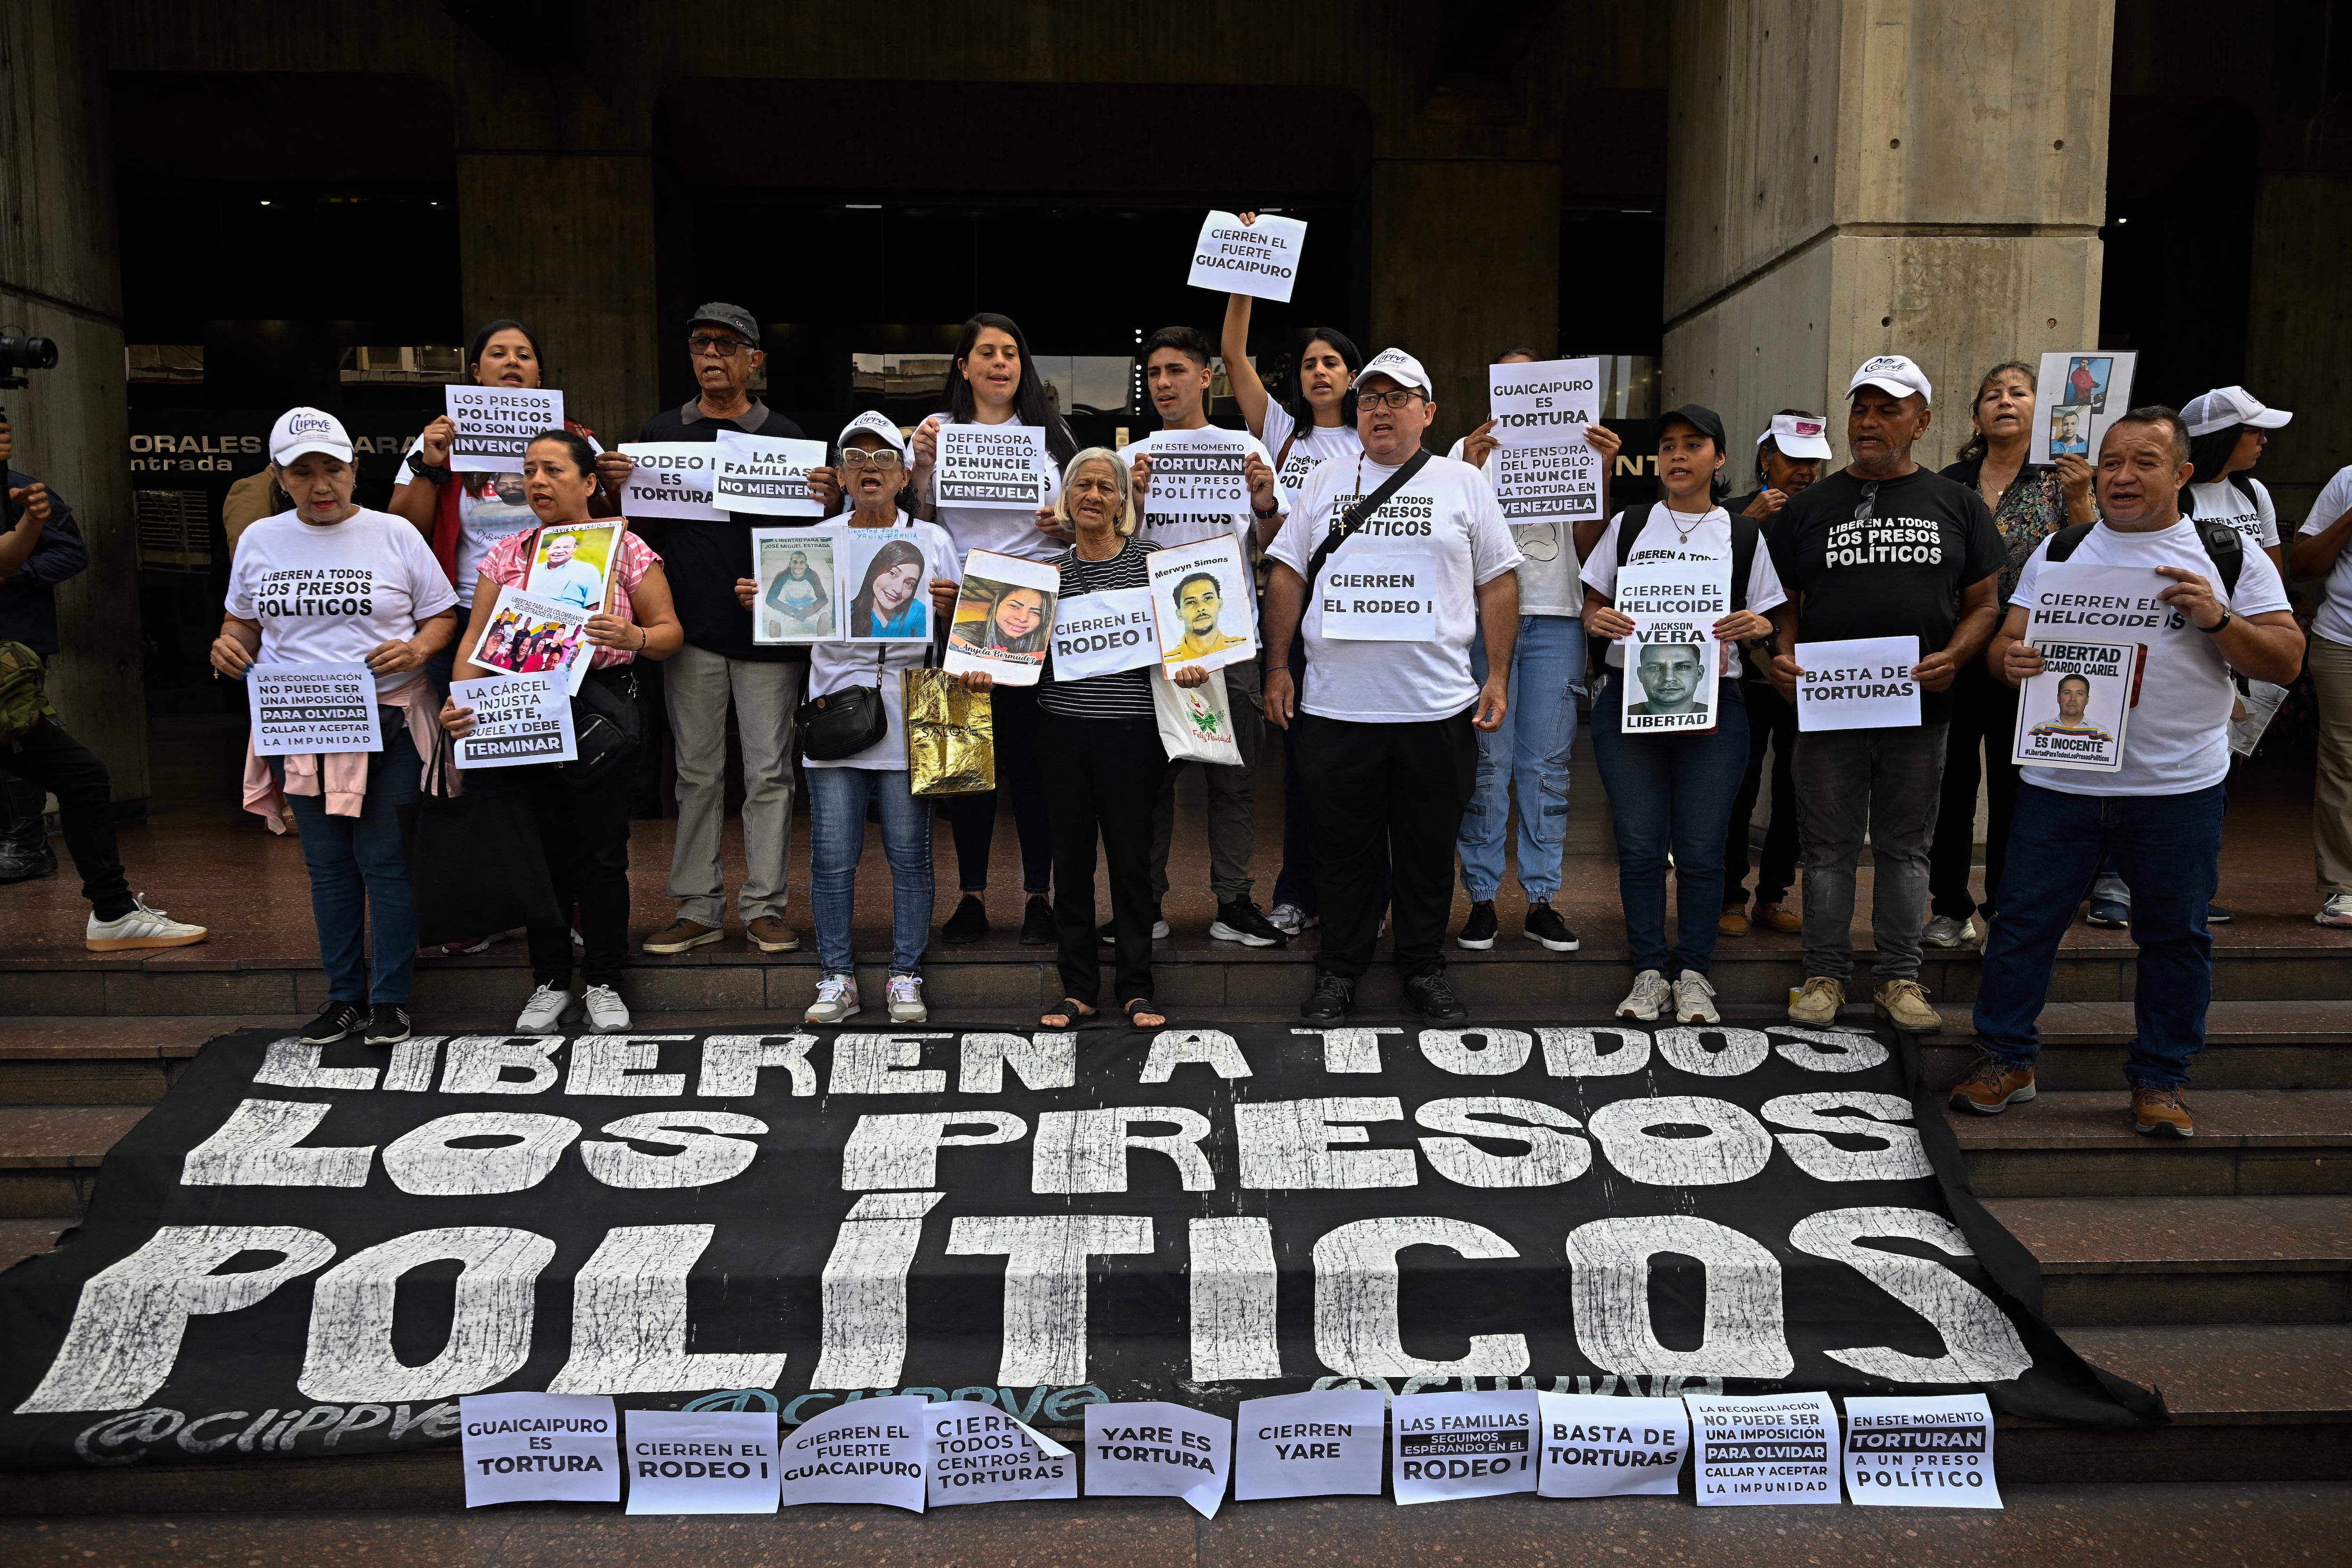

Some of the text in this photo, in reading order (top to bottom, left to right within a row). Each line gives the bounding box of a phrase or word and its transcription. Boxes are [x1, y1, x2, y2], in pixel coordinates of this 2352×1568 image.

[1211, 229, 1287, 249] CIERREN EL
[1221, 244, 1272, 260] FUERTE
[1196, 254, 1292, 278] GUACAIPURO
[1494, 380, 1593, 396] GUAICAIPURO
[454, 394, 550, 410] LOS PRESOS
[1536, 397, 1553, 408] ES
[457, 407, 552, 423] POLÍTICOS
[1500, 410, 1589, 428] TORTURA
[460, 422, 482, 433] NO
[485, 423, 515, 434] SON
[947, 433, 1032, 445] DEFENSORA
[753, 451, 787, 464] LAS
[946, 444, 1037, 457] DEL PUEBLO:
[725, 461, 813, 477] FAMILIAS
[946, 456, 1030, 470] DENUNCIE
[1152, 458, 1243, 471] TORTURAN
[660, 473, 682, 485] ES
[941, 469, 1038, 482] LA TORTURA EN
[1194, 476, 1240, 485] PRESO
[942, 484, 1037, 499] VENEZUELA
[1152, 485, 1241, 500] POLÍTICO
[1885, 518, 1895, 527] A
[1897, 517, 1939, 531] TODOS
[1828, 527, 1940, 549] LOS PRESOS
[1827, 546, 1941, 568] POLÍTICOS
[262, 569, 372, 582] LIBEREN A TODOS
[1154, 557, 1228, 579] Merwyn Simons
[259, 581, 371, 597] LOS PRESOS
[1330, 574, 1414, 588] CIERREN
[1622, 584, 1722, 596] CIERREN EL
[258, 595, 373, 618] POLÍTICOS
[511, 596, 532, 611] LIBERTAD
[532, 602, 544, 611] PARA
[552, 608, 585, 623] COLOMBIANOS
[1324, 599, 1432, 614] EL RODEO I
[1620, 600, 1723, 613] HELICOIDE
[2041, 593, 2161, 610] CIERREN EL
[514, 601, 547, 618] SECUESTRADOS
[553, 612, 578, 626] VENEZUELA
[2034, 610, 2160, 627] HELICOIDE
[1055, 611, 1151, 635] CIERREN EL
[1055, 627, 1152, 657] RODEO I
[1636, 630, 1706, 643] VERA
[960, 643, 1036, 665] Anyela Bermúdez
[2041, 644, 2122, 663] LIBERTAD
[1805, 665, 1908, 683] BASTA DE
[259, 684, 360, 694] NO PUEDE SER
[466, 680, 551, 700] LA CÁRCEL
[1802, 682, 1914, 701] TORTURAS
[260, 693, 365, 705] UNA IMPOSICIÓN
[479, 694, 541, 711] INJUSTA
[262, 709, 366, 720] PARA OLVIDAR
[476, 707, 541, 725] EXISTE,
[1627, 714, 1708, 728] LIBERTAD
[262, 725, 306, 734] CALLAR
[1192, 729, 1232, 744] Feliz Navidad
[288, 736, 370, 745] IMPUNIDAD
[466, 737, 560, 756] TERMINAR
[2034, 736, 2104, 753] ES INOCENTE
[1137, 1026, 1892, 1085] A TODOS
[250, 1033, 1078, 1100] LIBEREN
[180, 1098, 770, 1197] LOS
[842, 1093, 1937, 1196] PRESOS
[13, 1195, 2034, 1416] POLÍTICOS
[467, 1418, 608, 1436] GUAICAIPURO
[1400, 1413, 1529, 1432] LAS FAMILIAS
[1854, 1412, 1984, 1426] EN ESTE MOMENTO
[1101, 1427, 1211, 1452] YARE ES
[1258, 1423, 1352, 1440] CIERREN
[1431, 1432, 1499, 1443] SEGUIMOS
[1553, 1424, 1675, 1446] BASTA DE
[1853, 1432, 1982, 1447] TORTURAN
[529, 1436, 552, 1450] ES
[796, 1425, 909, 1457] CIERREN EL
[1406, 1441, 1525, 1454] ESPERANDO EN EL
[636, 1443, 767, 1457] CIERREN EL
[817, 1443, 890, 1459] FUERTE
[1275, 1442, 1340, 1460] YARE
[1548, 1447, 1679, 1467] TORTURAS
[477, 1455, 604, 1475] TORTURA
[1097, 1446, 1216, 1475] TORTURA
[1404, 1455, 1528, 1480] RODEO I
[1855, 1455, 1978, 1465] A UN PRESO
[638, 1461, 768, 1479] RODEO I
[784, 1461, 921, 1481] GUACAIPURO
[1857, 1466, 1983, 1487] POLÍTICO
